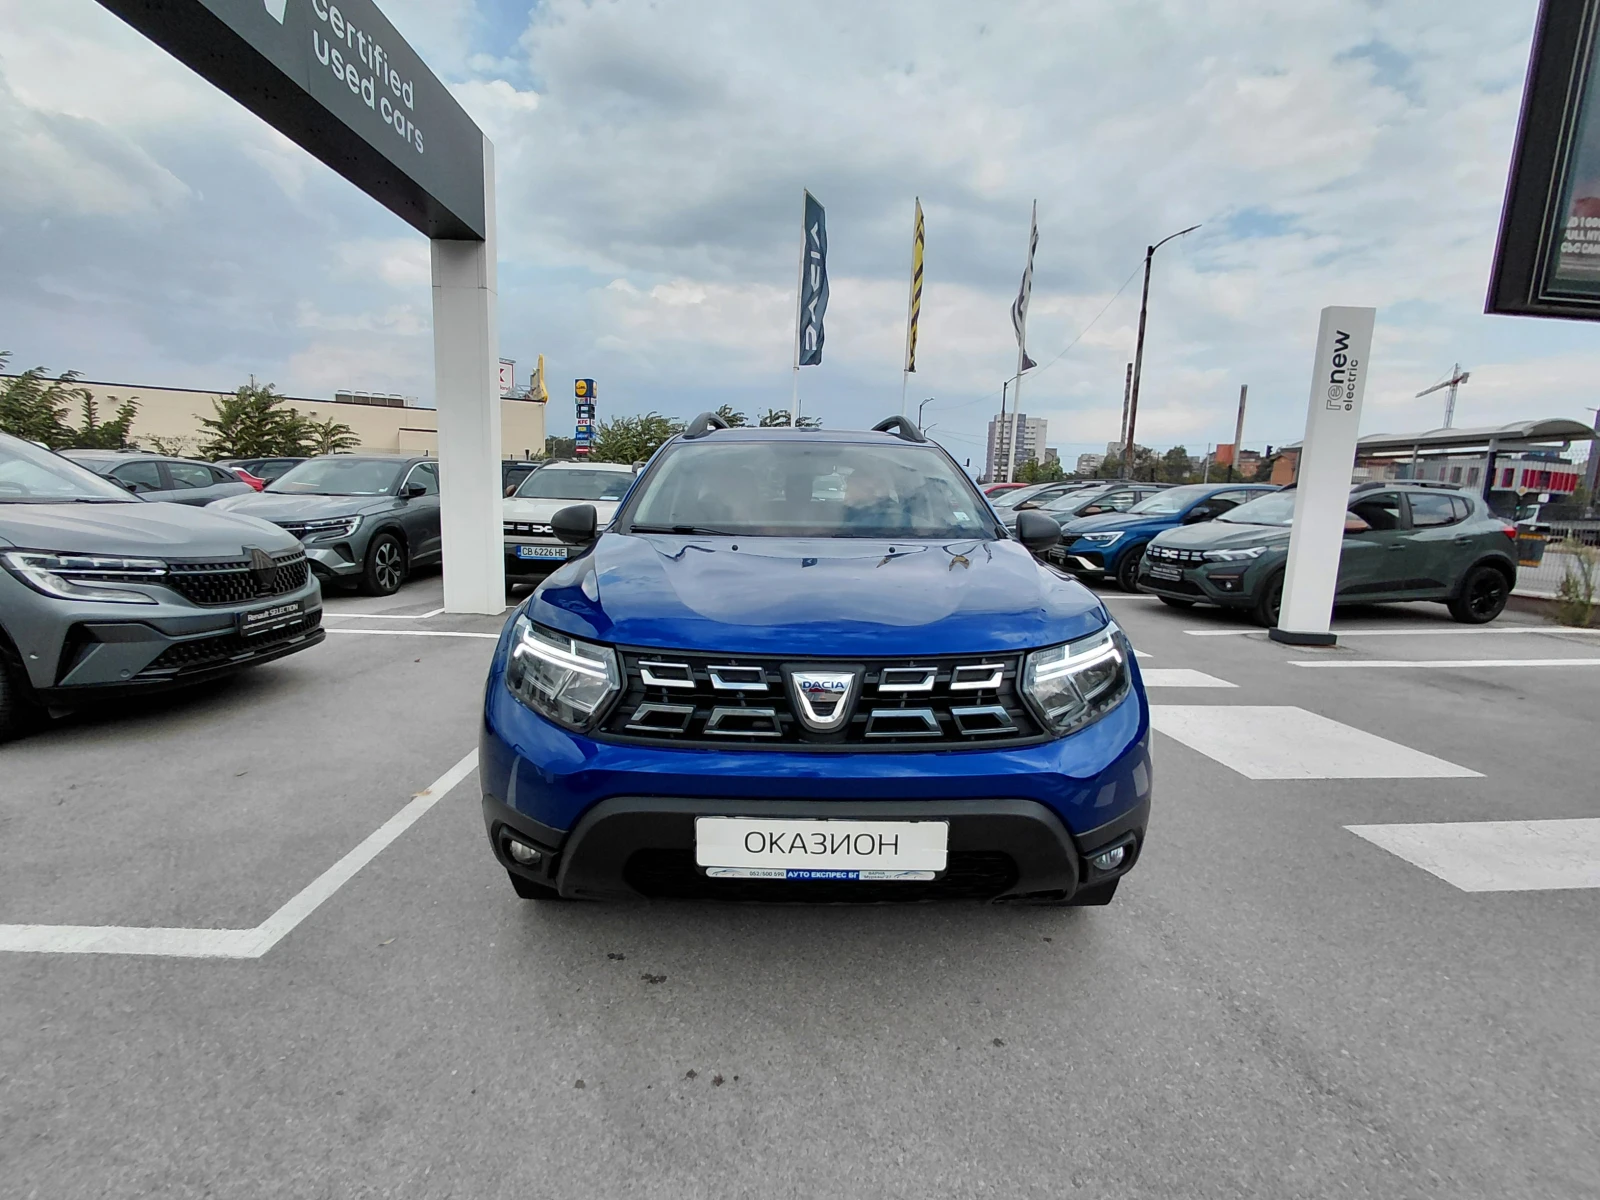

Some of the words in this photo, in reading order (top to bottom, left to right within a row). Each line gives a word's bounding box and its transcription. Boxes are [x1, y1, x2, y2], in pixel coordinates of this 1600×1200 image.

[311, 0, 413, 111] certified
[313, 29, 375, 110] used
[380, 97, 424, 154] cars
[1326, 330, 1350, 410] renew
[1343, 359, 1358, 411] electric
[534, 547, 554, 556] 6226
[270, 604, 298, 616] SELECTION
[802, 681, 845, 689] DACIA
[744, 831, 899, 856] ОКАЗИОН
[787, 870, 809, 878] АУТО
[811, 871, 847, 879] ЕКСПРЕС
